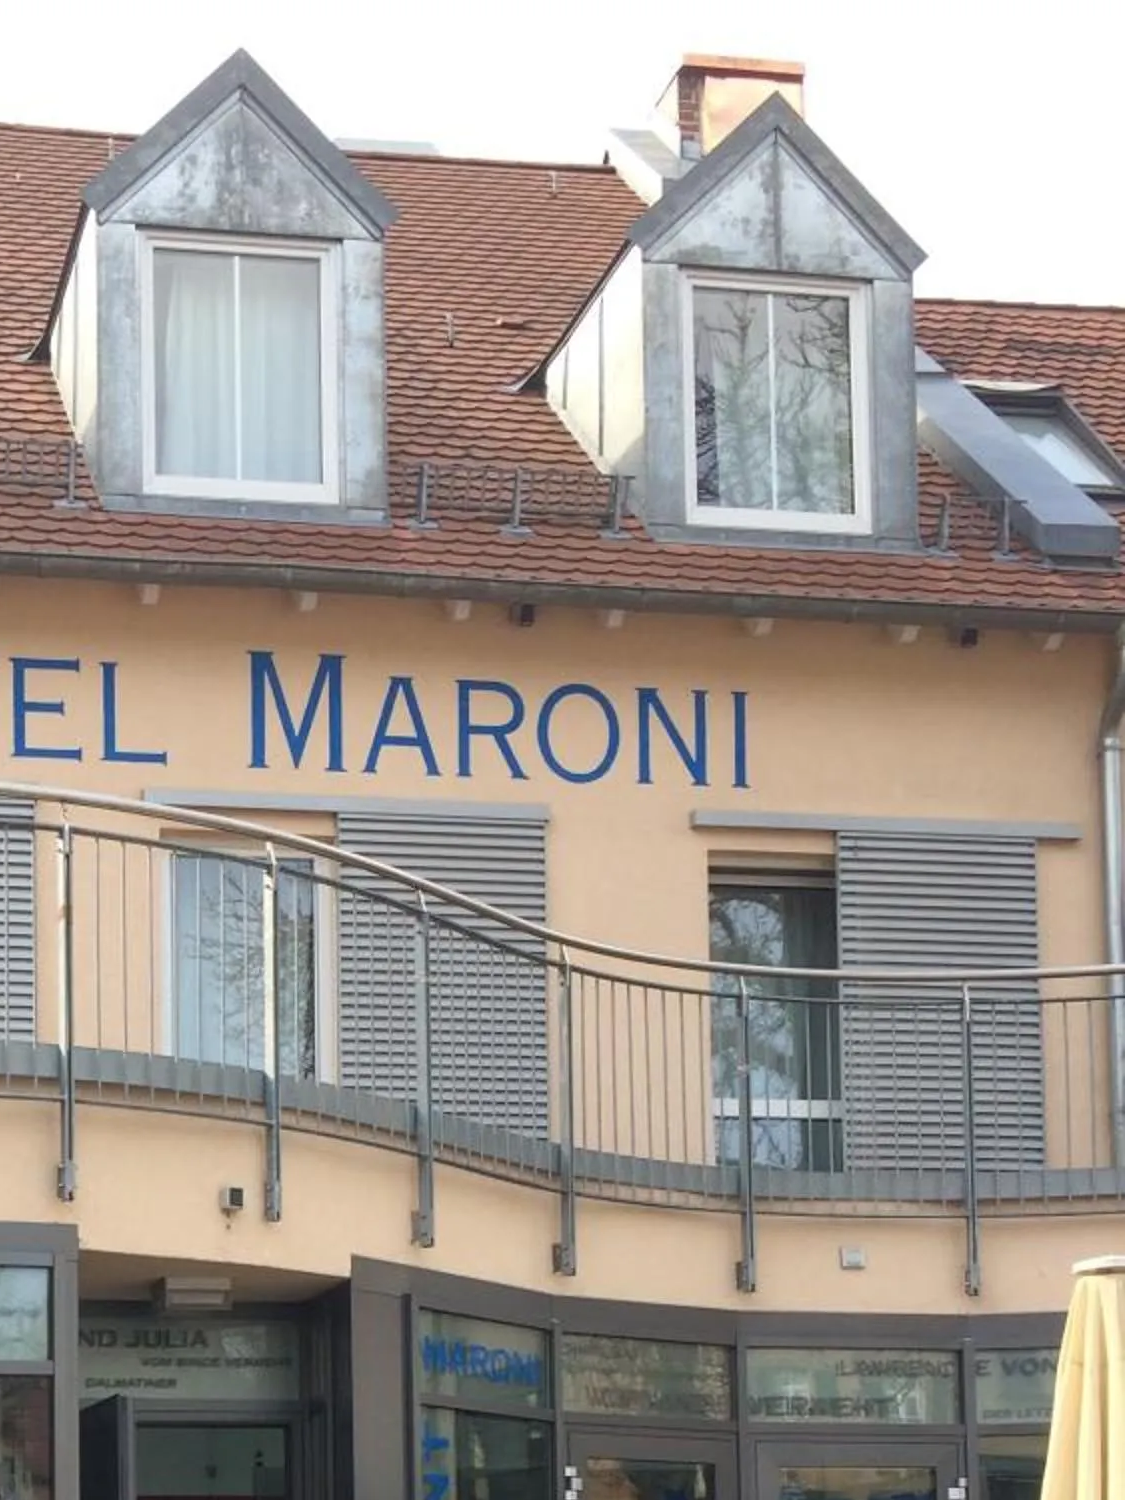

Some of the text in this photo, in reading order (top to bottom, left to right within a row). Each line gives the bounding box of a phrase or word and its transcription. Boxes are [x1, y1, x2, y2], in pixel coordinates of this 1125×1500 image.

[247, 648, 752, 789] MARONI
[78, 1328, 210, 1349] ND JULIA
